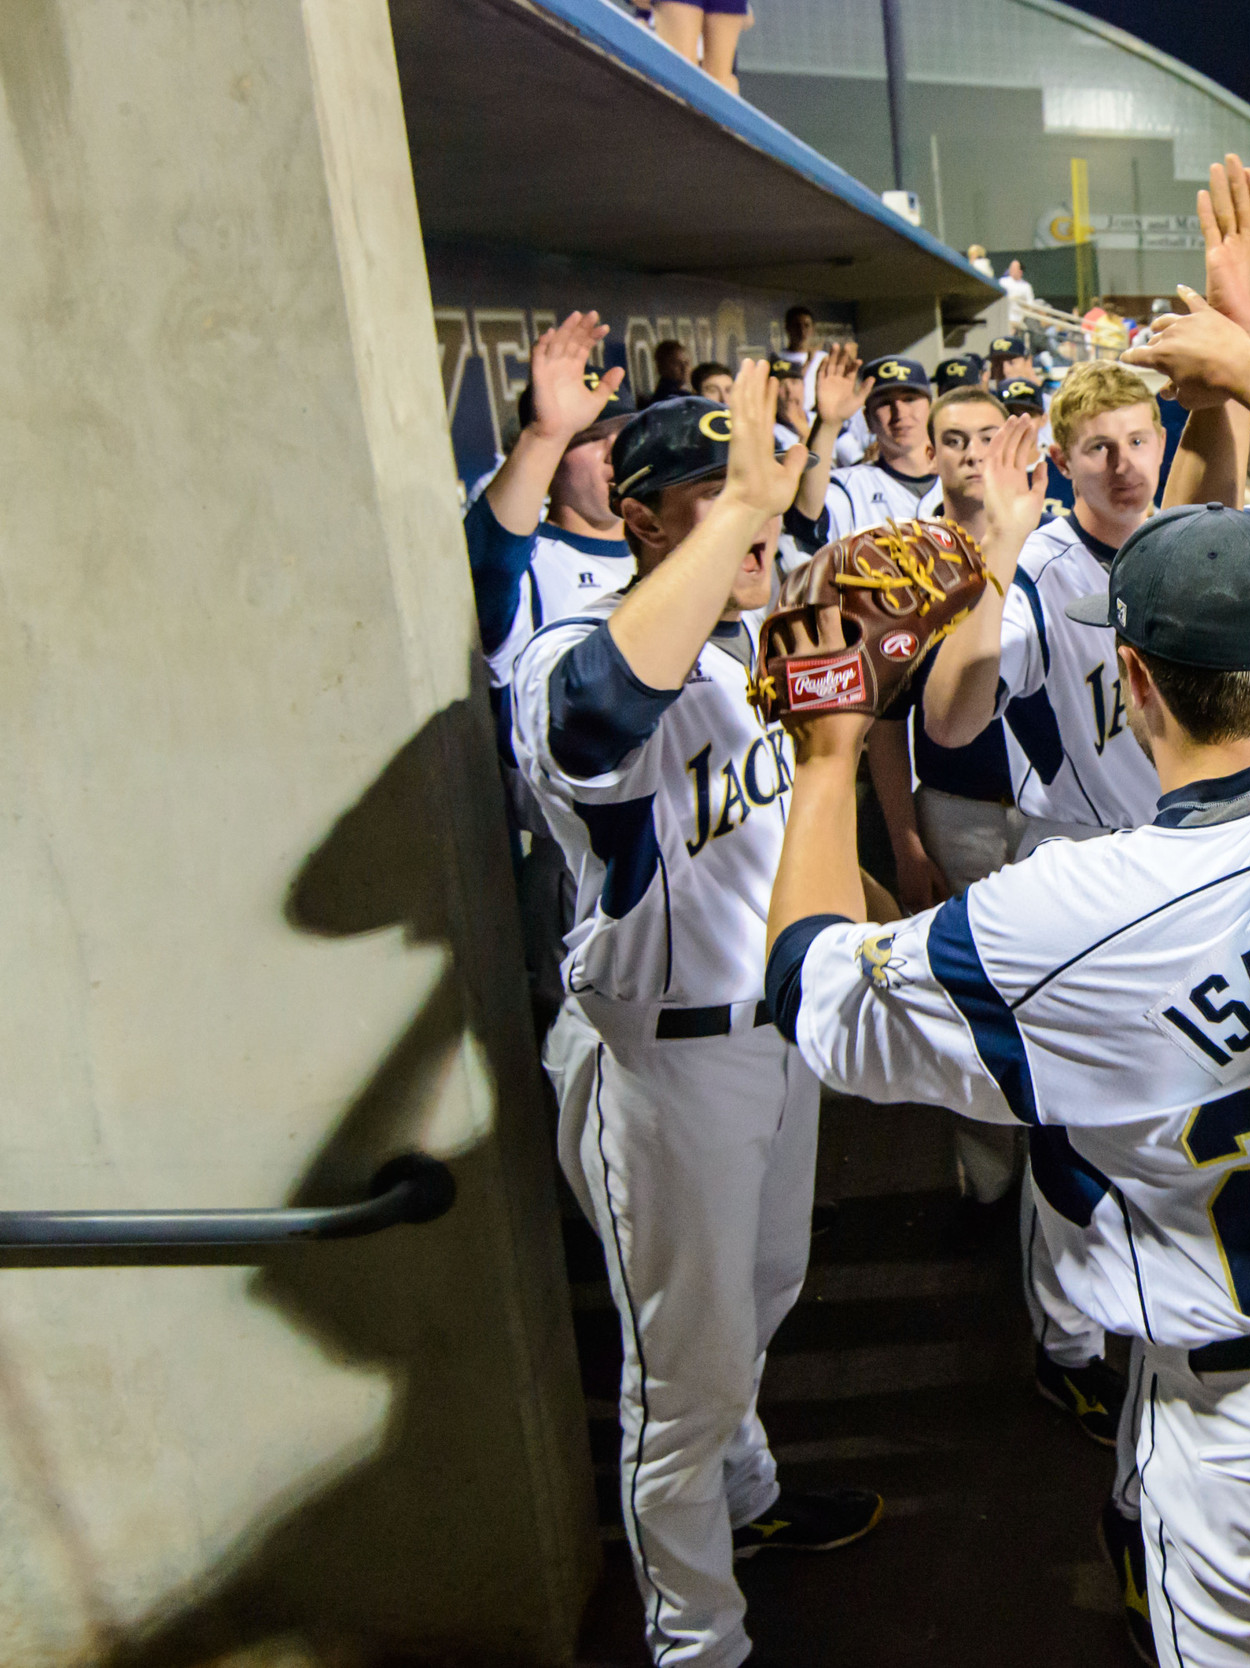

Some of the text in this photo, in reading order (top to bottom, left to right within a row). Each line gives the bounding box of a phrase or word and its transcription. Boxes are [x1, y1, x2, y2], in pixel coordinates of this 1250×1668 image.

[878, 360, 911, 381] GT
[946, 361, 968, 378] GT
[698, 408, 733, 442] G
[794, 667, 857, 697] Rawlings
[686, 726, 797, 858] JACK
